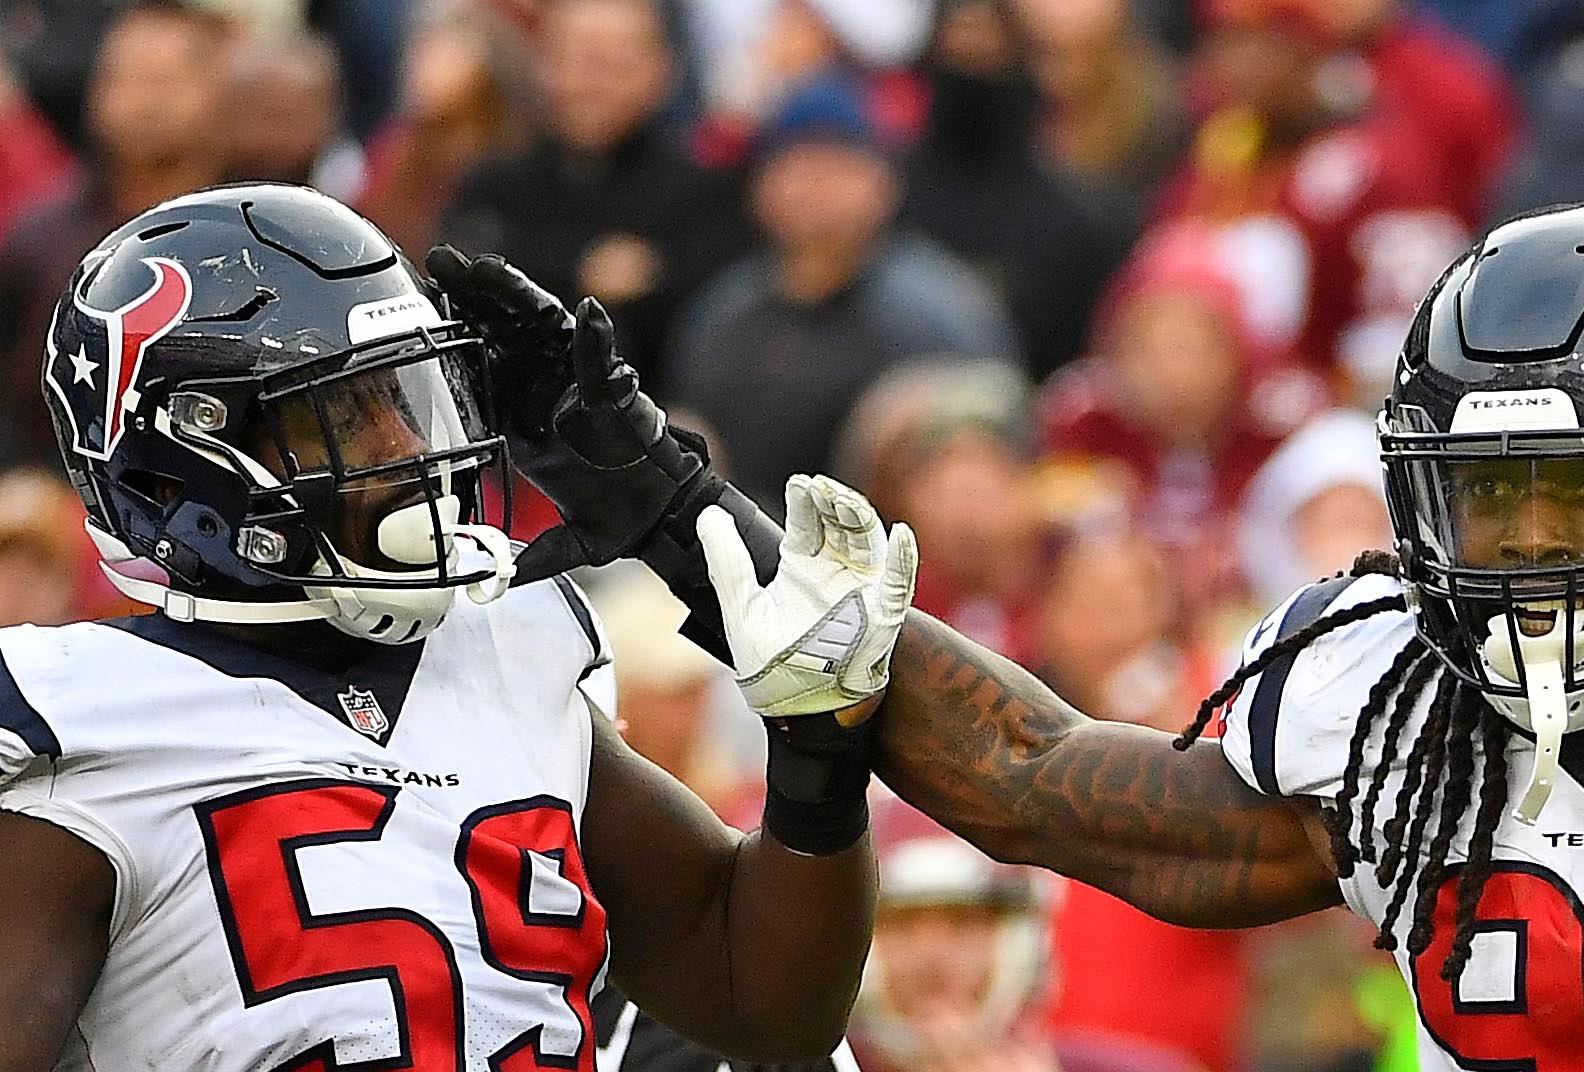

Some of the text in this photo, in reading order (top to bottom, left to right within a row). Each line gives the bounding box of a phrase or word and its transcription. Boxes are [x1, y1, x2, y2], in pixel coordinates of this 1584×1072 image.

[364, 301, 423, 319] TEXANS
[1468, 397, 1553, 410] TEXANS
[334, 761, 460, 788] TEXANS
